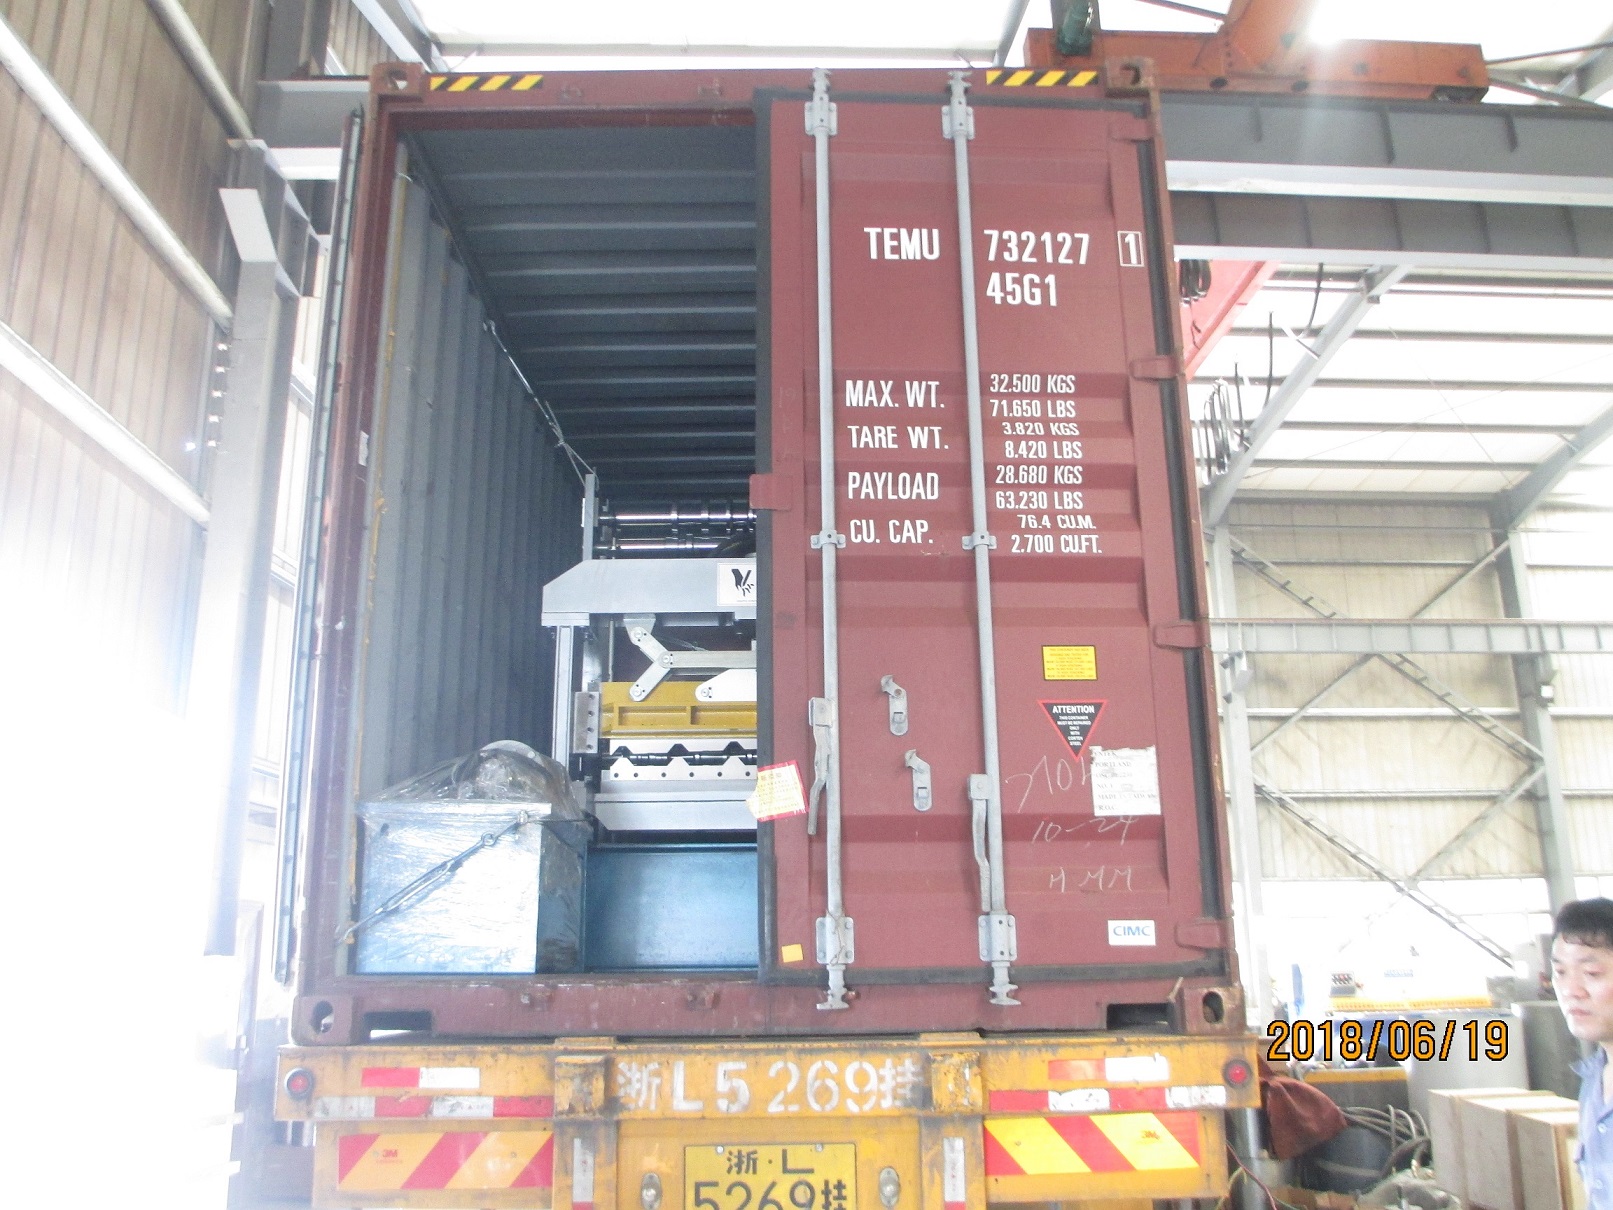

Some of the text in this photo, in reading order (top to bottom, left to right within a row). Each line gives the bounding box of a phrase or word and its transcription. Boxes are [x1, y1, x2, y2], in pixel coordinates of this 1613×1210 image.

[863, 227, 940, 260] TEMU
[983, 229, 1091, 265] 732127
[986, 272, 1058, 306] 45G1
[845, 374, 1076, 408] MAX. WT. 32.500 KGS
[990, 400, 1076, 418] 71.650 LBS
[847, 422, 1080, 450] TARE WT. 3.820 KGS
[1005, 441, 1082, 459] 8.420 LBS
[848, 465, 1083, 500] PAYLOAD 28.680 KGS
[995, 491, 1083, 510] 63.230 LBS
[850, 519, 881, 544] CU.
[888, 519, 934, 544] CAP.
[1017, 515, 1051, 529] 76.4
[1011, 535, 1054, 553] 2.700
[1052, 705, 1095, 714] ATTENTION
[1112, 924, 1151, 937] CIMC
